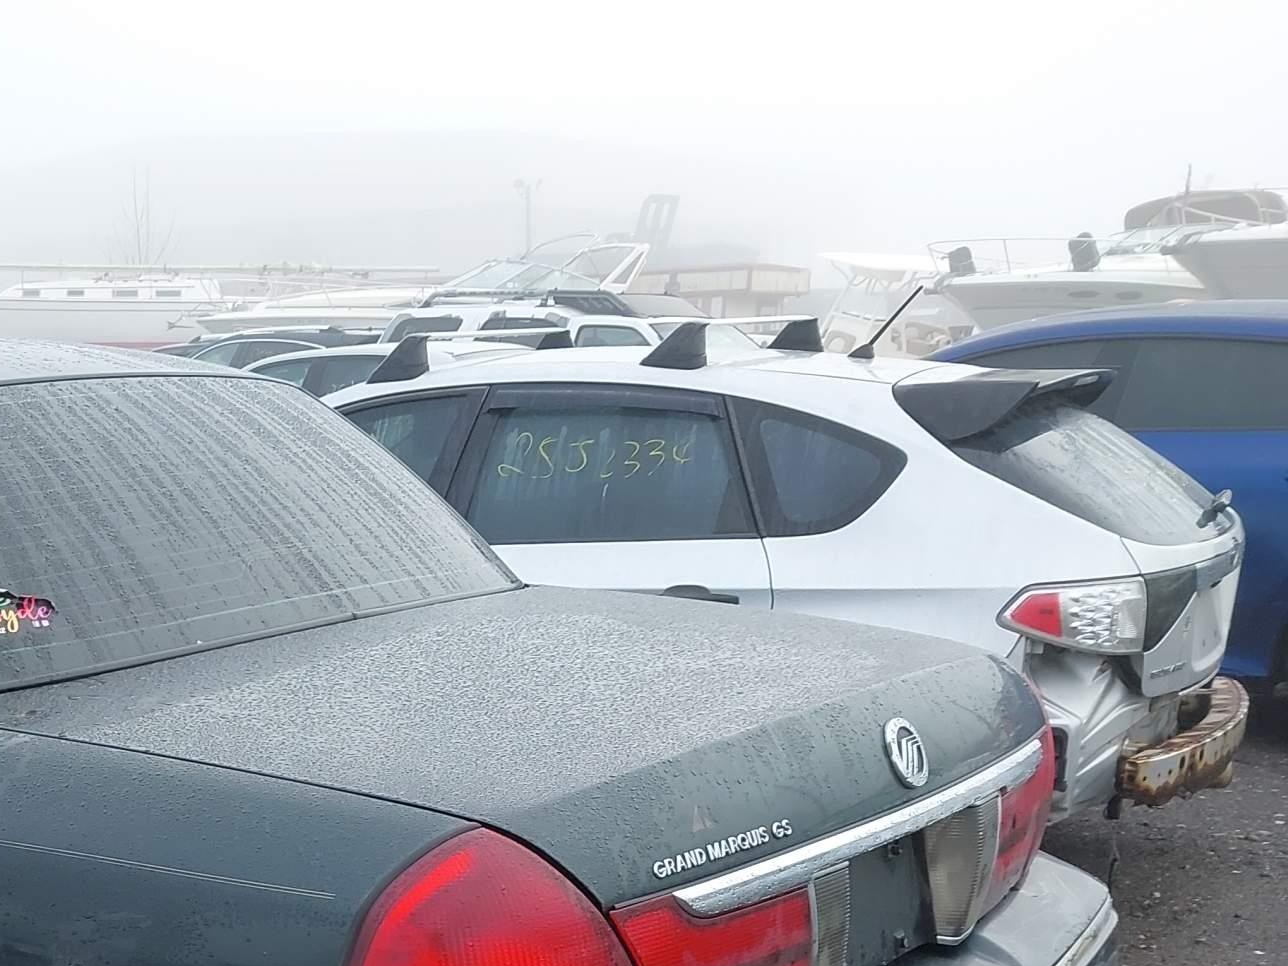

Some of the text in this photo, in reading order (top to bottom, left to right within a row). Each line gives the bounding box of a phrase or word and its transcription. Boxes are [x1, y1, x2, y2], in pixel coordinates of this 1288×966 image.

[652, 818, 794, 878] GRAND MARQUIS GS
